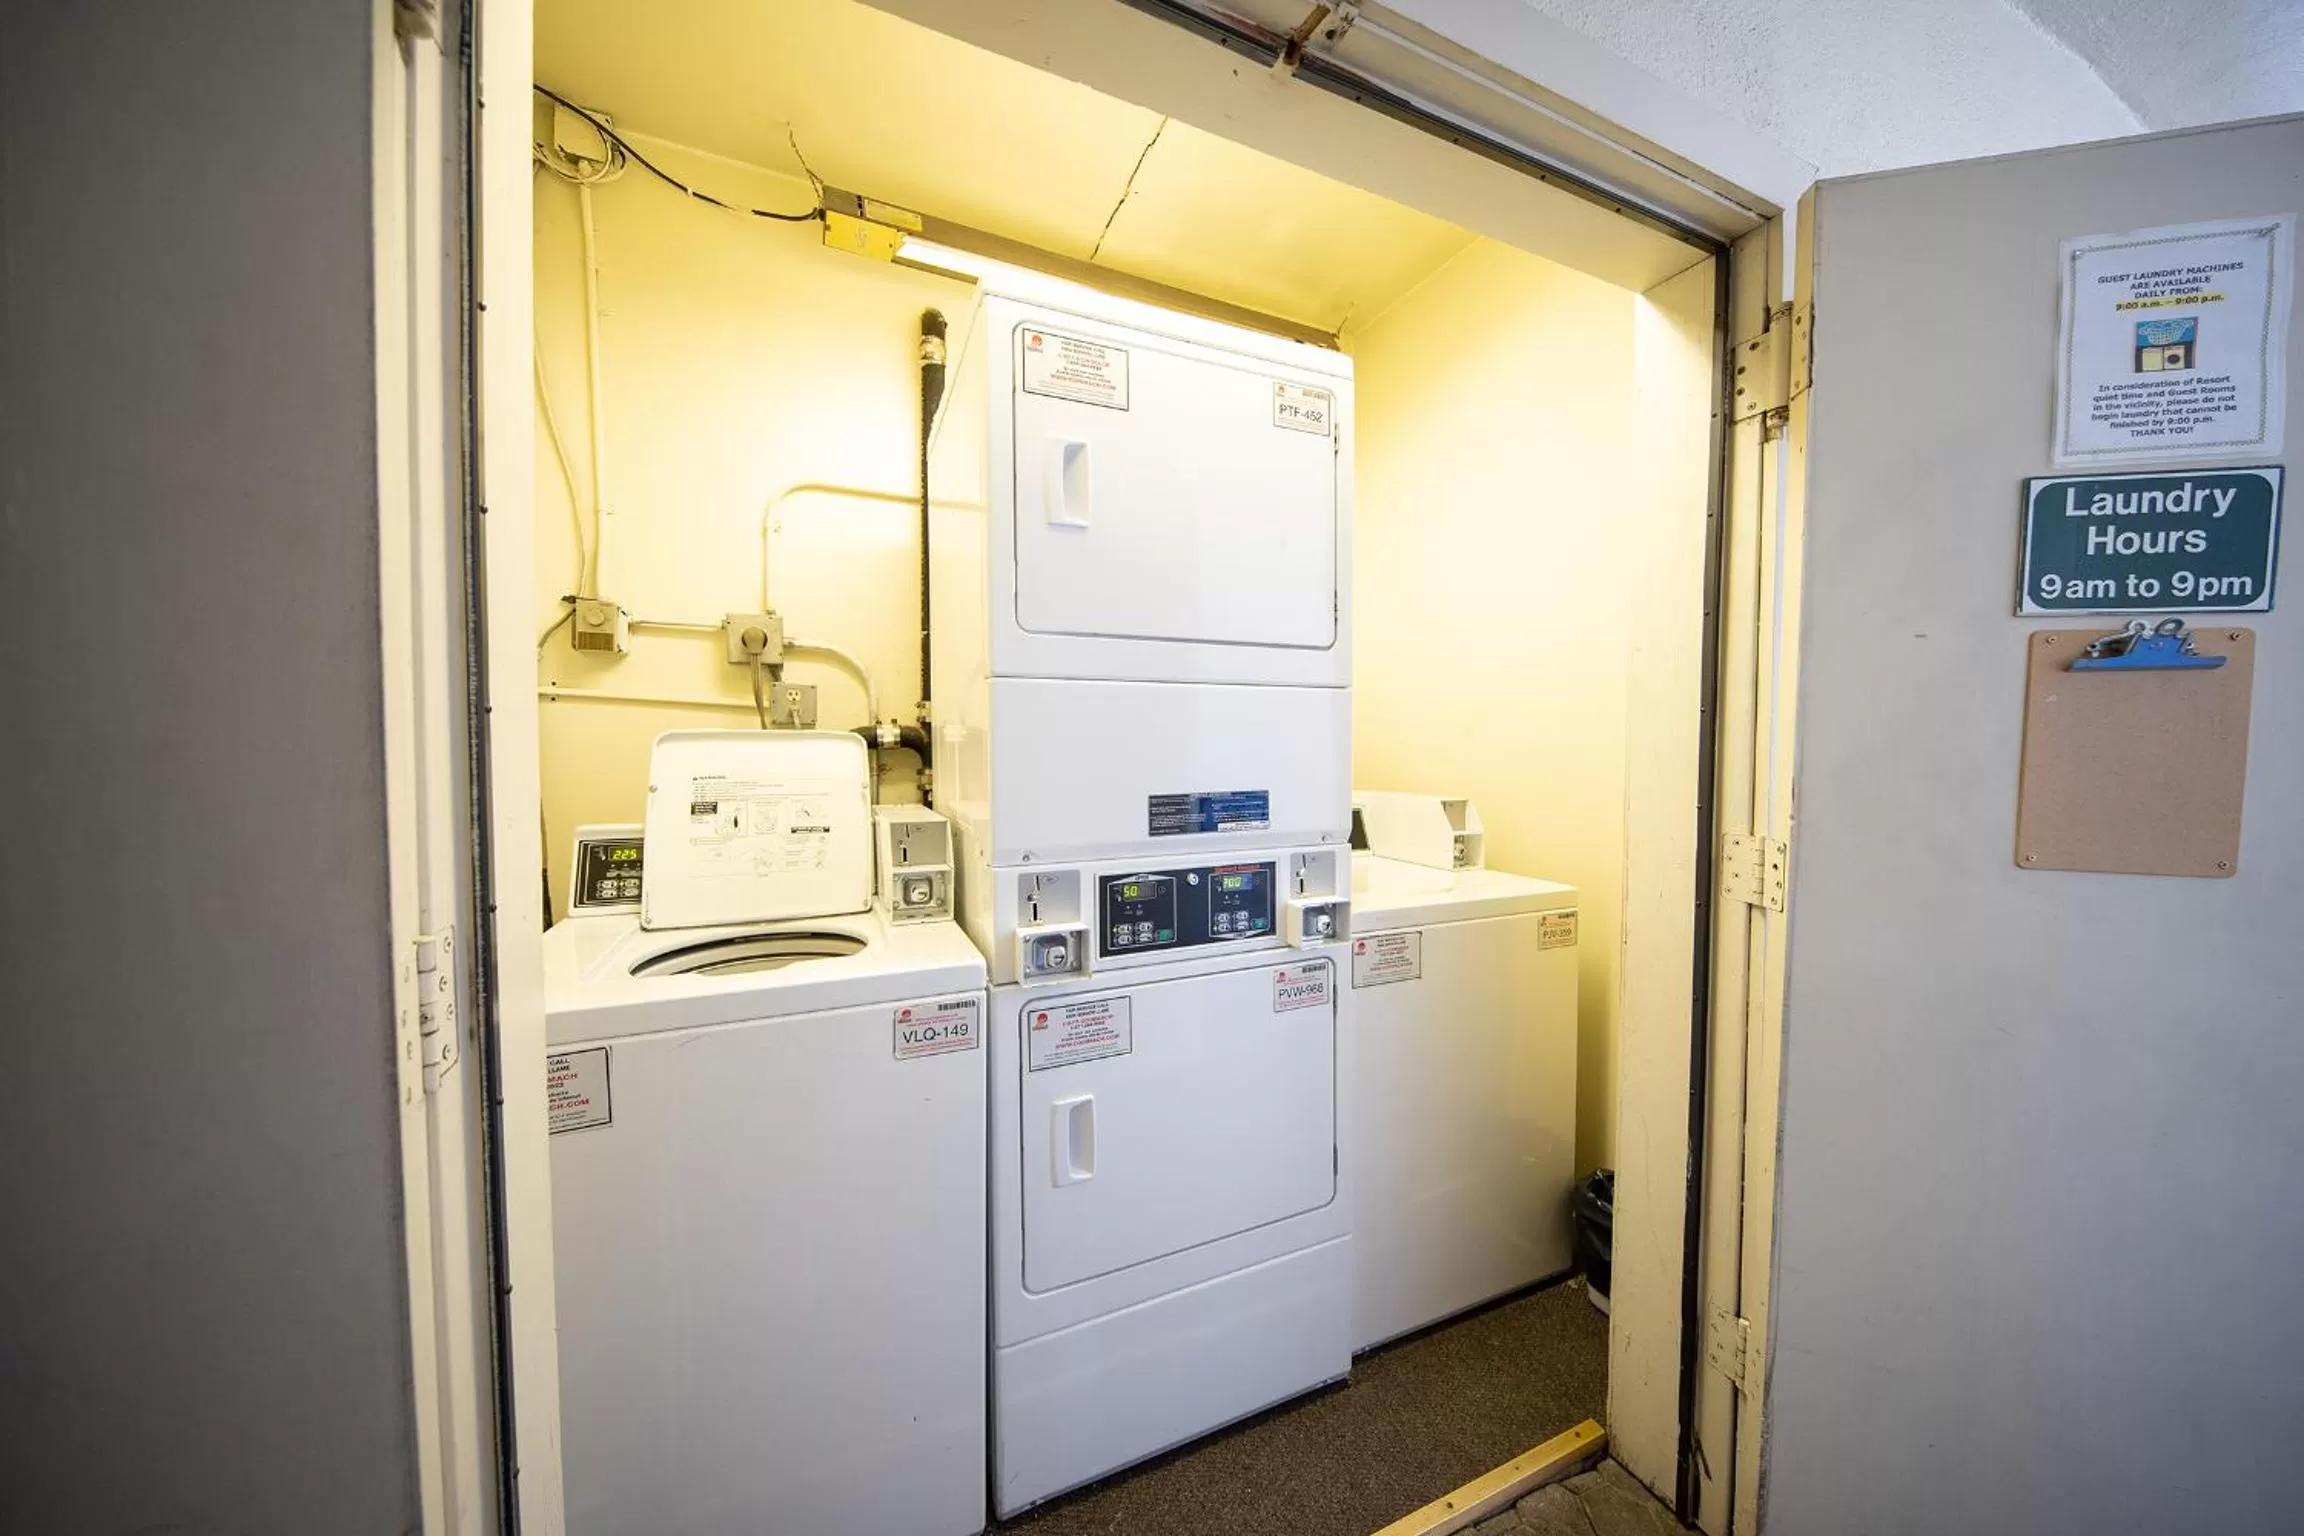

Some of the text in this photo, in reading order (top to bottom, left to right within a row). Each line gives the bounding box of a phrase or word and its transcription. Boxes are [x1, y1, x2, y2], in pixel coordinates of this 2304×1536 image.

[2098, 262, 2243, 283] GUEST LAUNDRY MACHINES
[2130, 275, 2211, 290] ARE AVAILABLE
[2134, 286, 2203, 299] DAILY FROM:
[2175, 296, 2199, 304] 9:00
[2201, 294, 2224, 304] p.m.
[2112, 380, 2180, 391] consideration
[2183, 378, 2194, 386] of
[2196, 376, 2231, 384] Resort
[2093, 385, 2236, 403] quiet time and Guest Rooms
[2105, 402, 2122, 410] the
[2124, 400, 2163, 410] vicinity,
[2167, 398, 2199, 407] please
[2218, 394, 2235, 402] not
[1279, 403, 1323, 423] PTF-452
[2091, 413, 2119, 421] begin
[2121, 410, 2158, 419] laundry
[2162, 408, 2183, 416] that
[2185, 405, 2221, 414] cannot
[2110, 416, 2215, 429] finished by 9:00 p.m.
[2130, 426, 2194, 437] THANK YOU!
[2065, 482, 2237, 518] Laundry
[2087, 525, 2207, 555] Hours
[2040, 571, 2253, 601] 9am to 9pm
